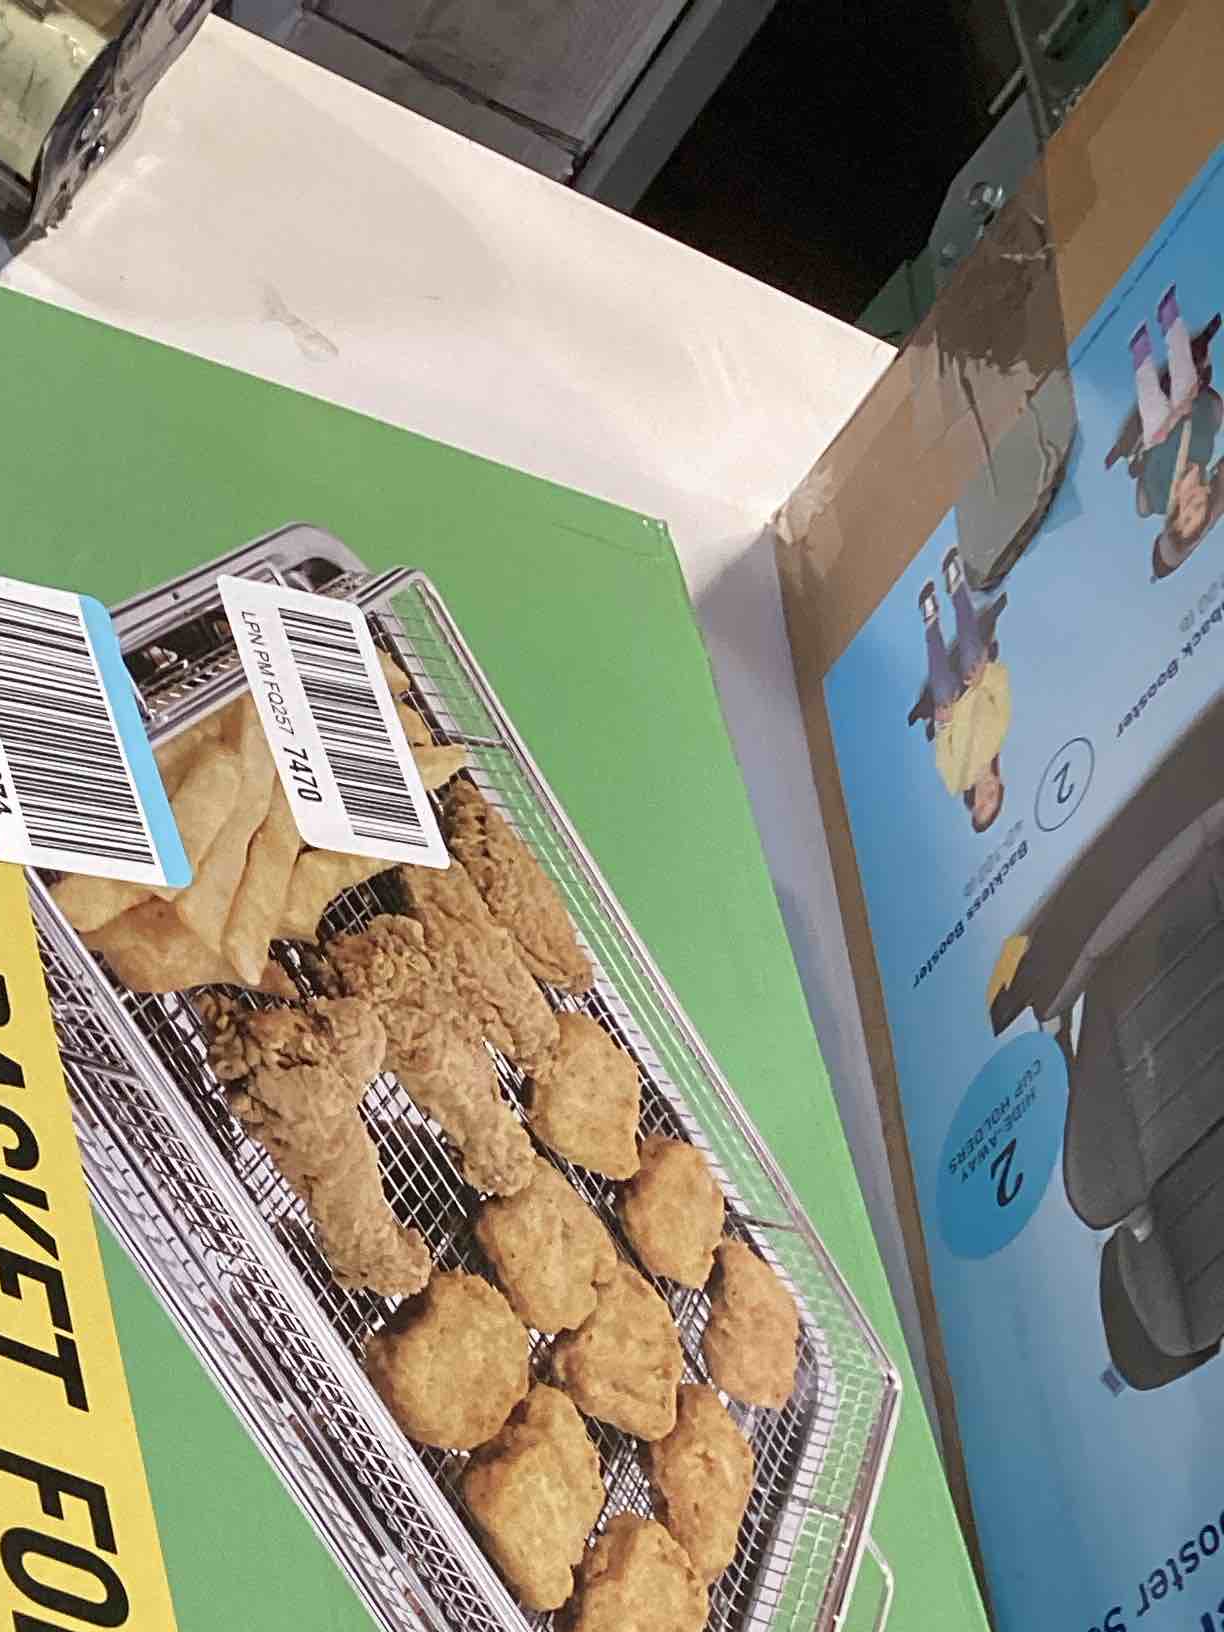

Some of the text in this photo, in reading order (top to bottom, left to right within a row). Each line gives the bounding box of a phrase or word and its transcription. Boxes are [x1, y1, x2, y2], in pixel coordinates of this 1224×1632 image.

[1115, 658, 1180, 739] Booster
[284, 746, 324, 803] 7470
[1052, 760, 1076, 805] 2
[966, 839, 1028, 920] Backless
[912, 920, 966, 989] Booster
[990, 1137, 1024, 1207] 2
